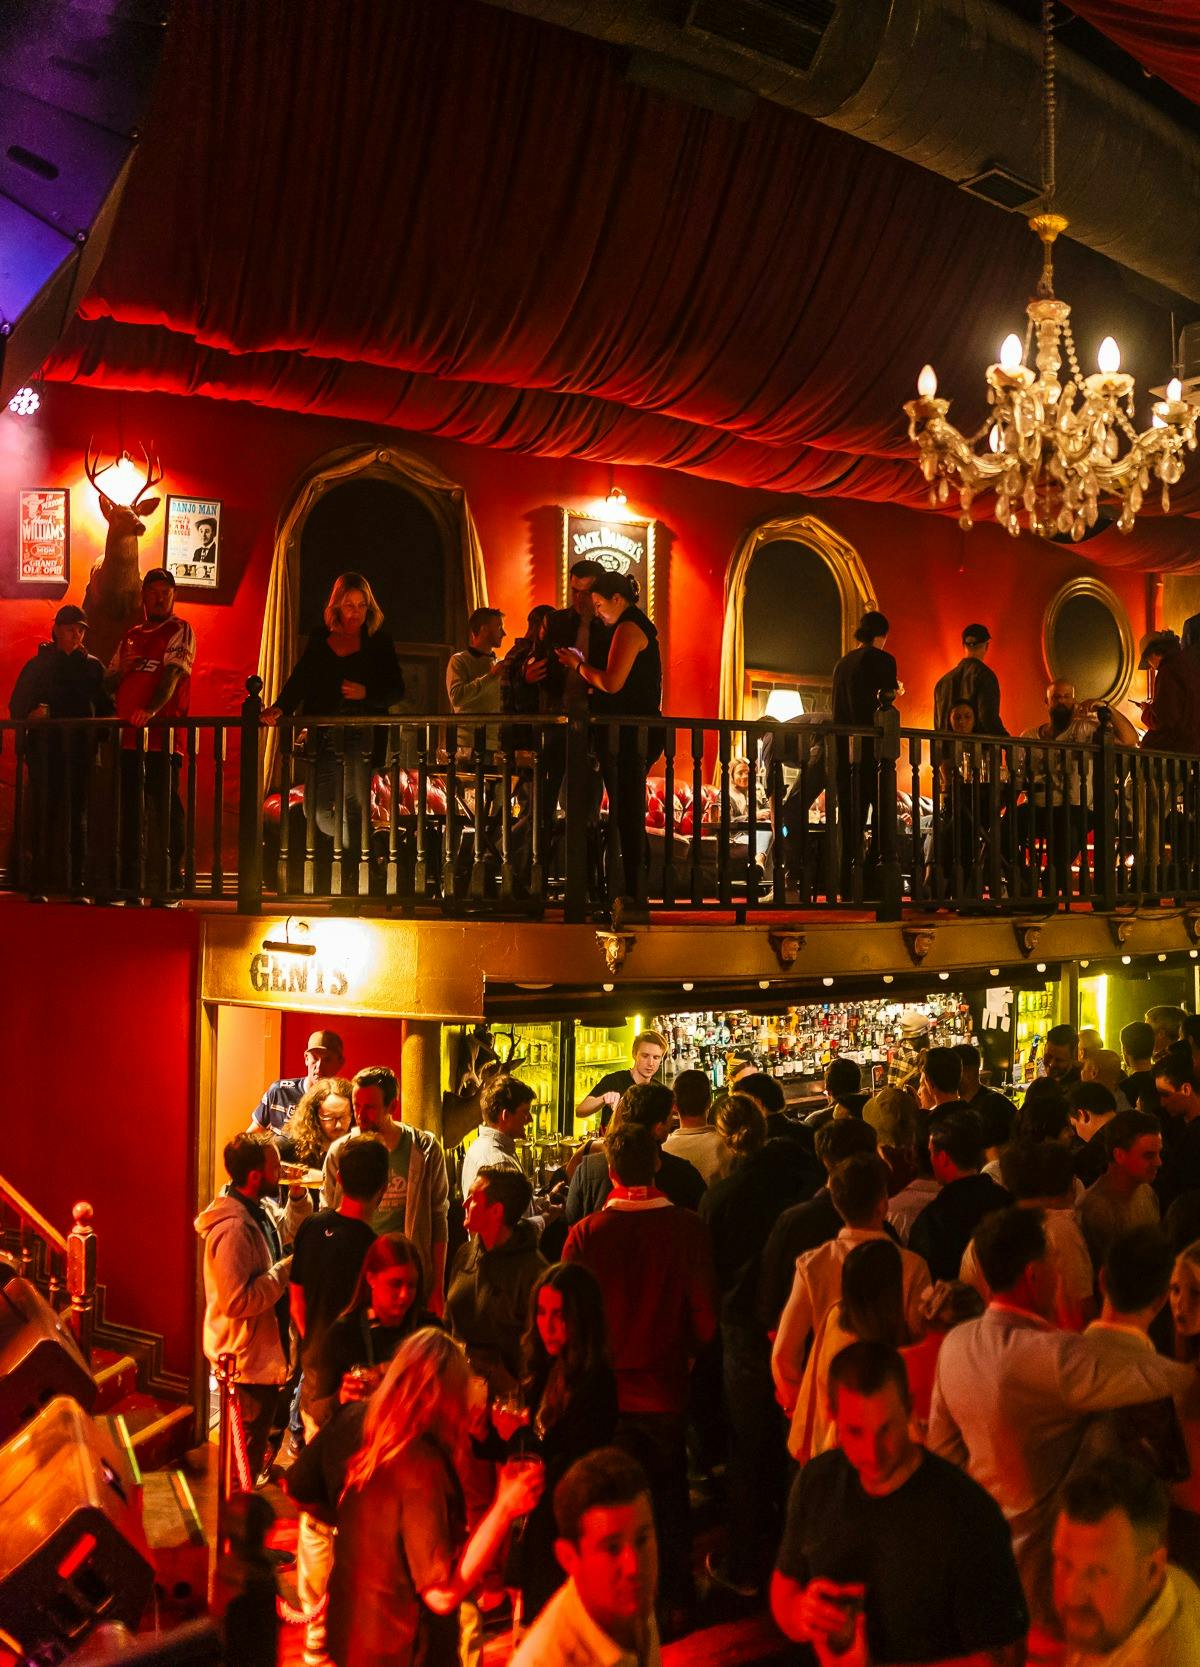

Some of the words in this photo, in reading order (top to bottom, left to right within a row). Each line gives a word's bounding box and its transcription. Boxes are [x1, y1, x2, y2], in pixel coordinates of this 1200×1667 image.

[199, 504, 217, 516] MAN
[23, 523, 65, 541] WILLIAMS
[573, 530, 603, 555] JACK
[250, 952, 348, 996] GENTS
